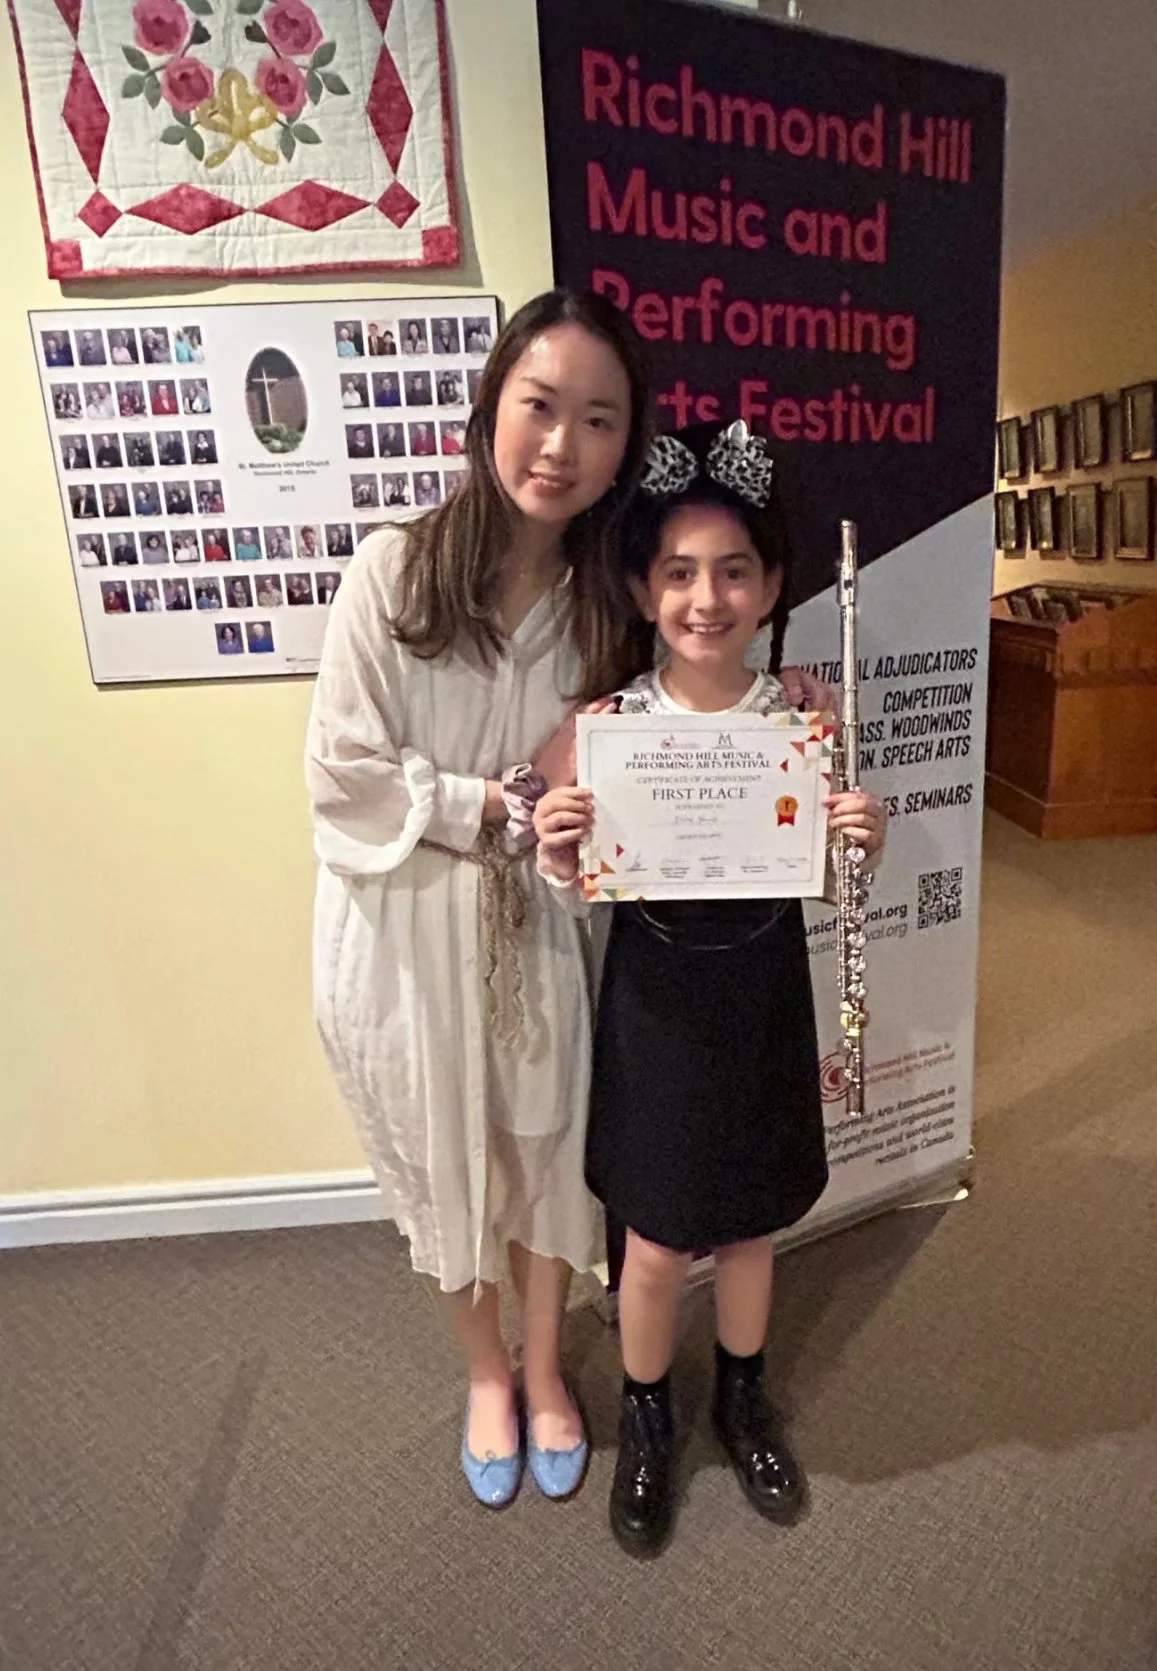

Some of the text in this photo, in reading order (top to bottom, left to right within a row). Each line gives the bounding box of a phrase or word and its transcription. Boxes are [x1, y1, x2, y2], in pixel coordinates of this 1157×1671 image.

[581, 47, 973, 183] Richmond Hill
[586, 161, 888, 263] Music and
[739, 379, 935, 444] Festival
[874, 648, 978, 680] ADJUDICATORS
[883, 683, 973, 714] COMPETITION
[892, 709, 972, 740] WOODWINDS
[625, 759, 771, 770] PERFORMING ARTS FESTIVAL
[633, 752, 694, 761] RICHMOND
[696, 752, 719, 761] HILL
[722, 751, 754, 760] MUSIC
[881, 740, 934, 768] SPEECH
[935, 735, 971, 759] ARTS
[652, 787, 748, 801] FIRST PLACE
[904, 783, 973, 814] SEMINARS
